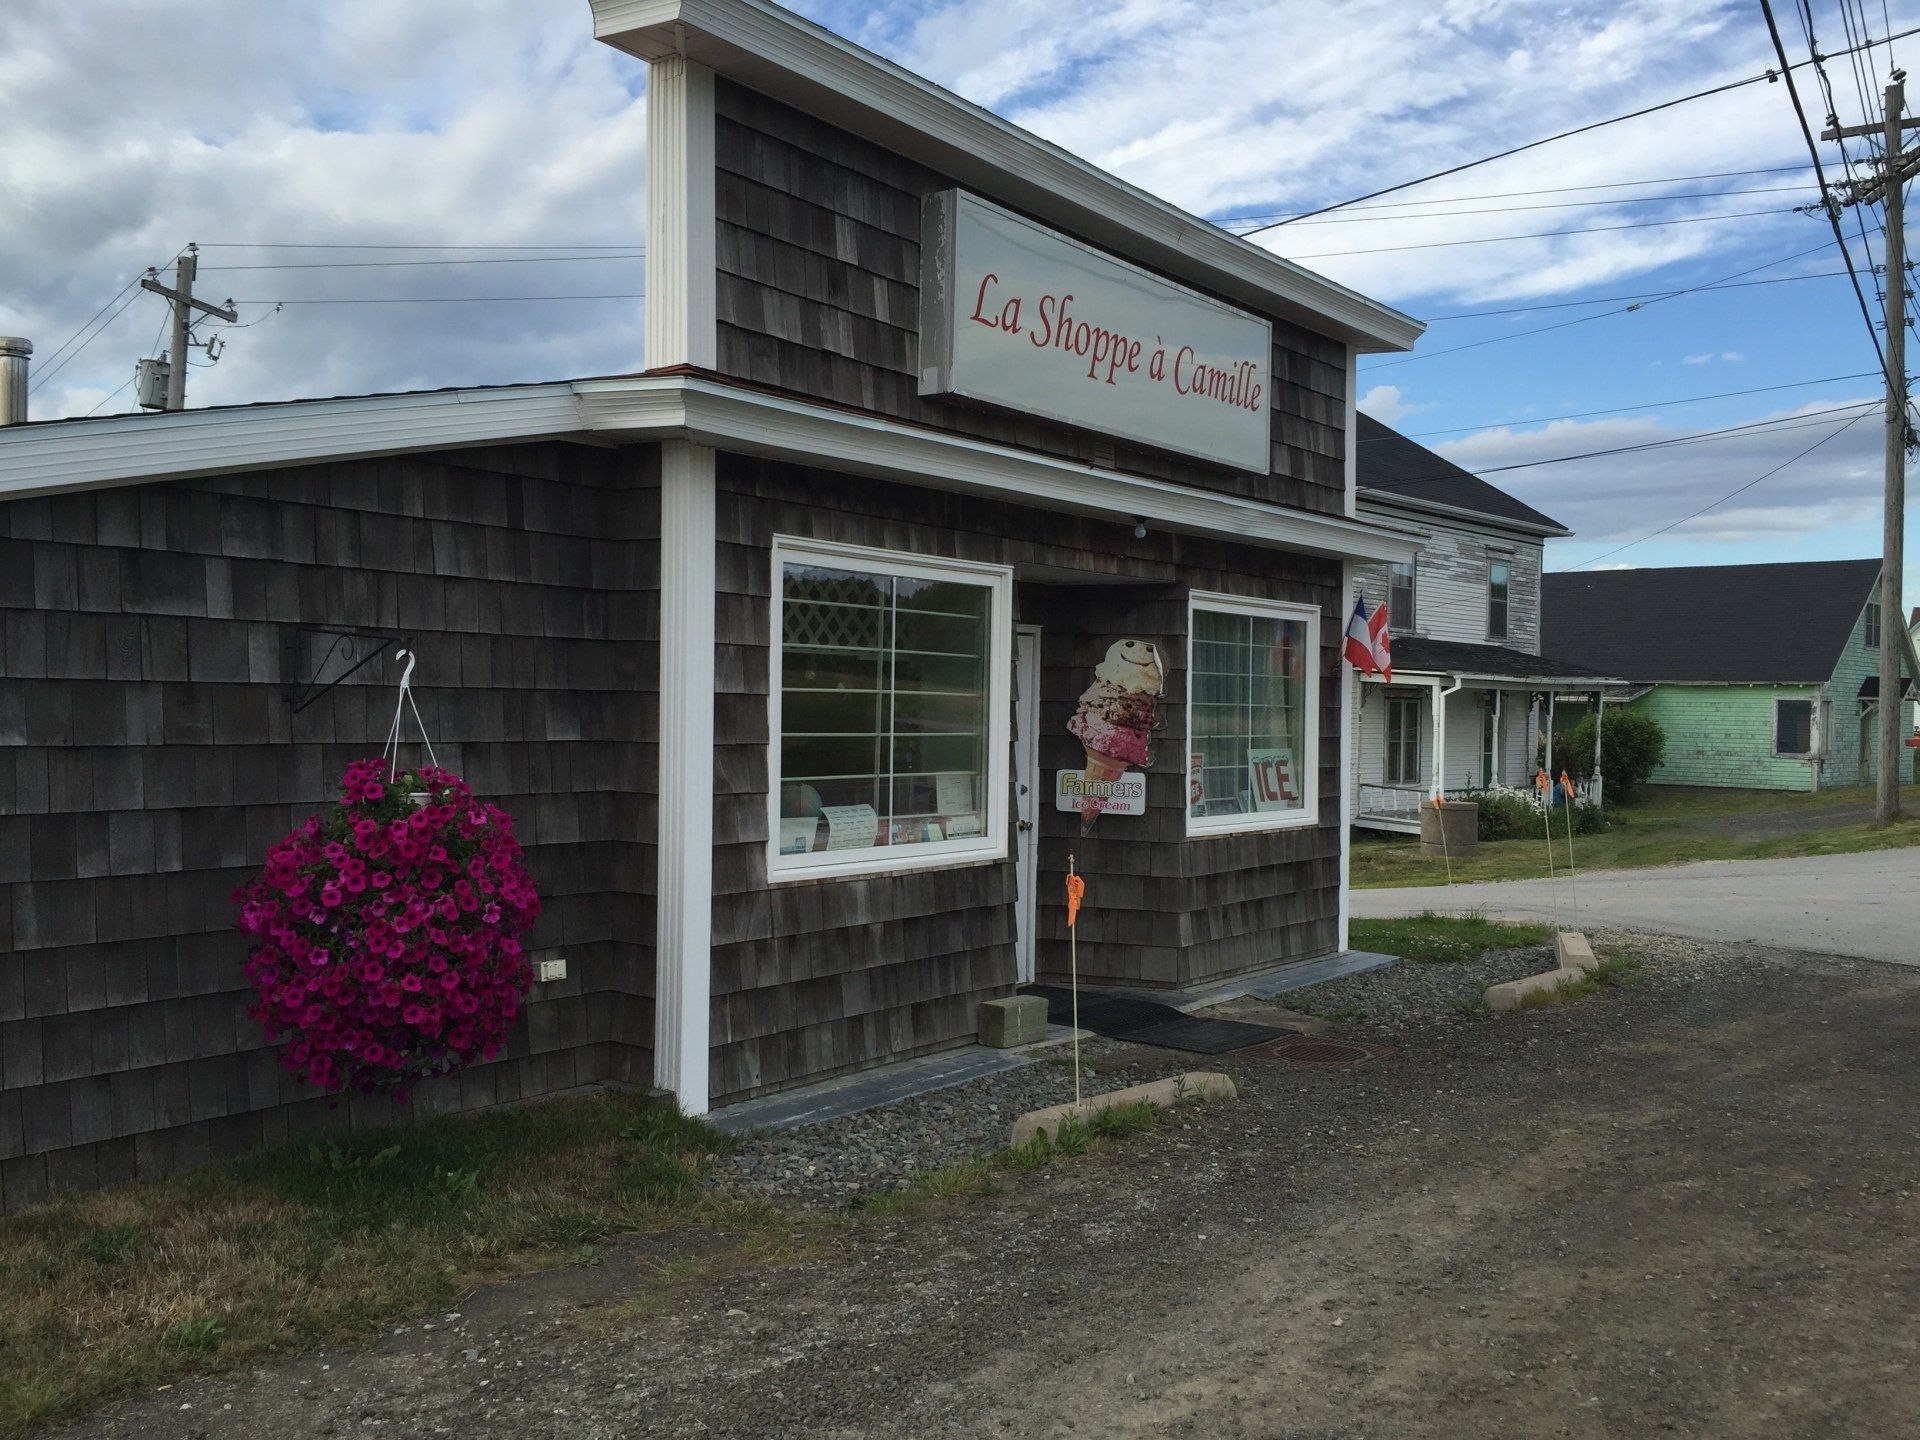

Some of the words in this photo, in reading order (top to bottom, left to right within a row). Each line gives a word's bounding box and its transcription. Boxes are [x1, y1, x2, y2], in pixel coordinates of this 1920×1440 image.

[970, 274, 1022, 334] La
[1030, 294, 1141, 386] Shoppe
[1150, 336, 1165, 382] à
[1174, 346, 1262, 413] Camille
[1061, 772, 1143, 798] Farmers
[1252, 756, 1294, 802] ICE
[1090, 799, 1131, 811] Cream
